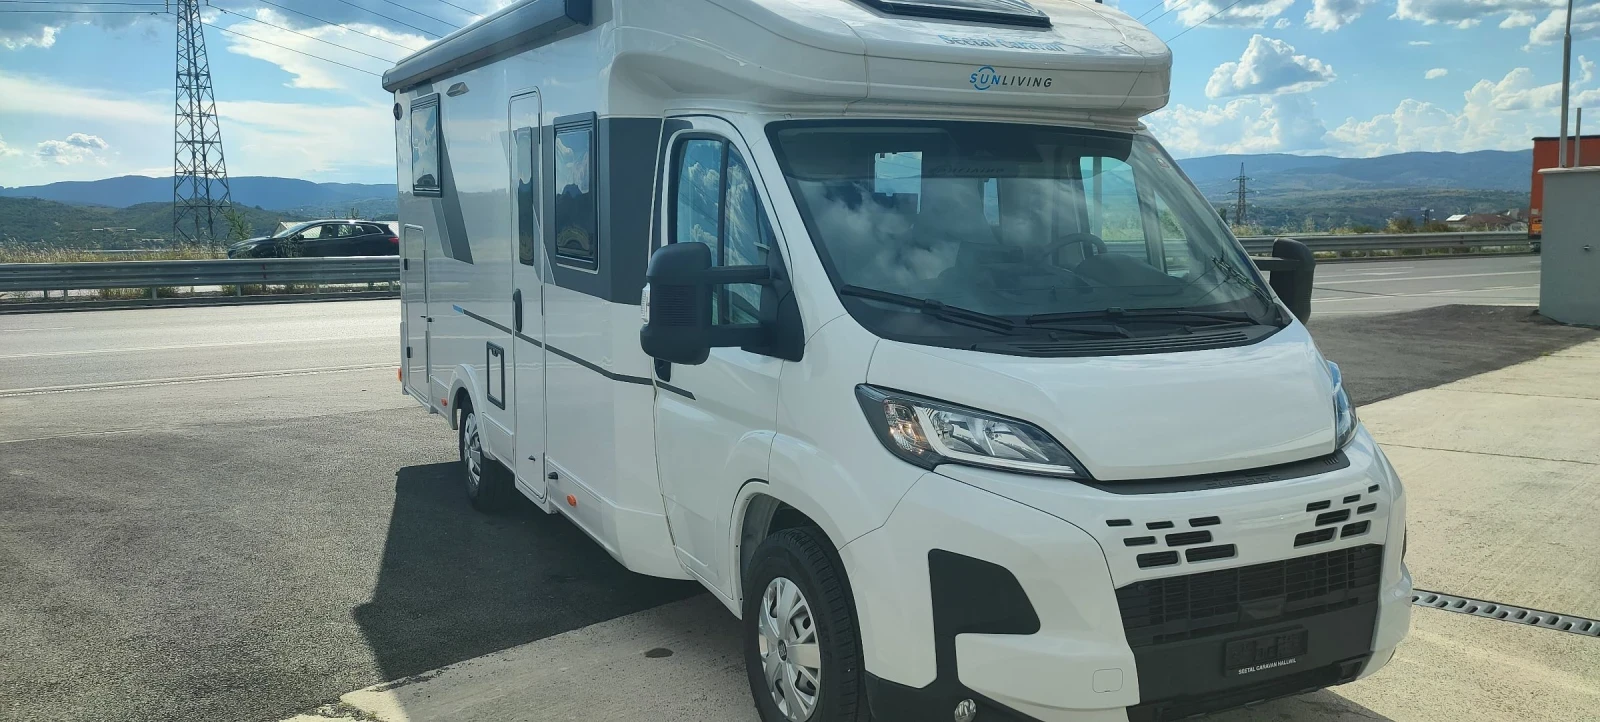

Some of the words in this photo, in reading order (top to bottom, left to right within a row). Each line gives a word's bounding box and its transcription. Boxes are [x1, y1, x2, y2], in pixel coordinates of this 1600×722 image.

[937, 34, 999, 48] Seetal
[996, 38, 1066, 52] Caravan
[969, 72, 1053, 88] SUNLIVING
[1238, 667, 1256, 675] SEETAL
[1256, 662, 1277, 671] CARAVAN
